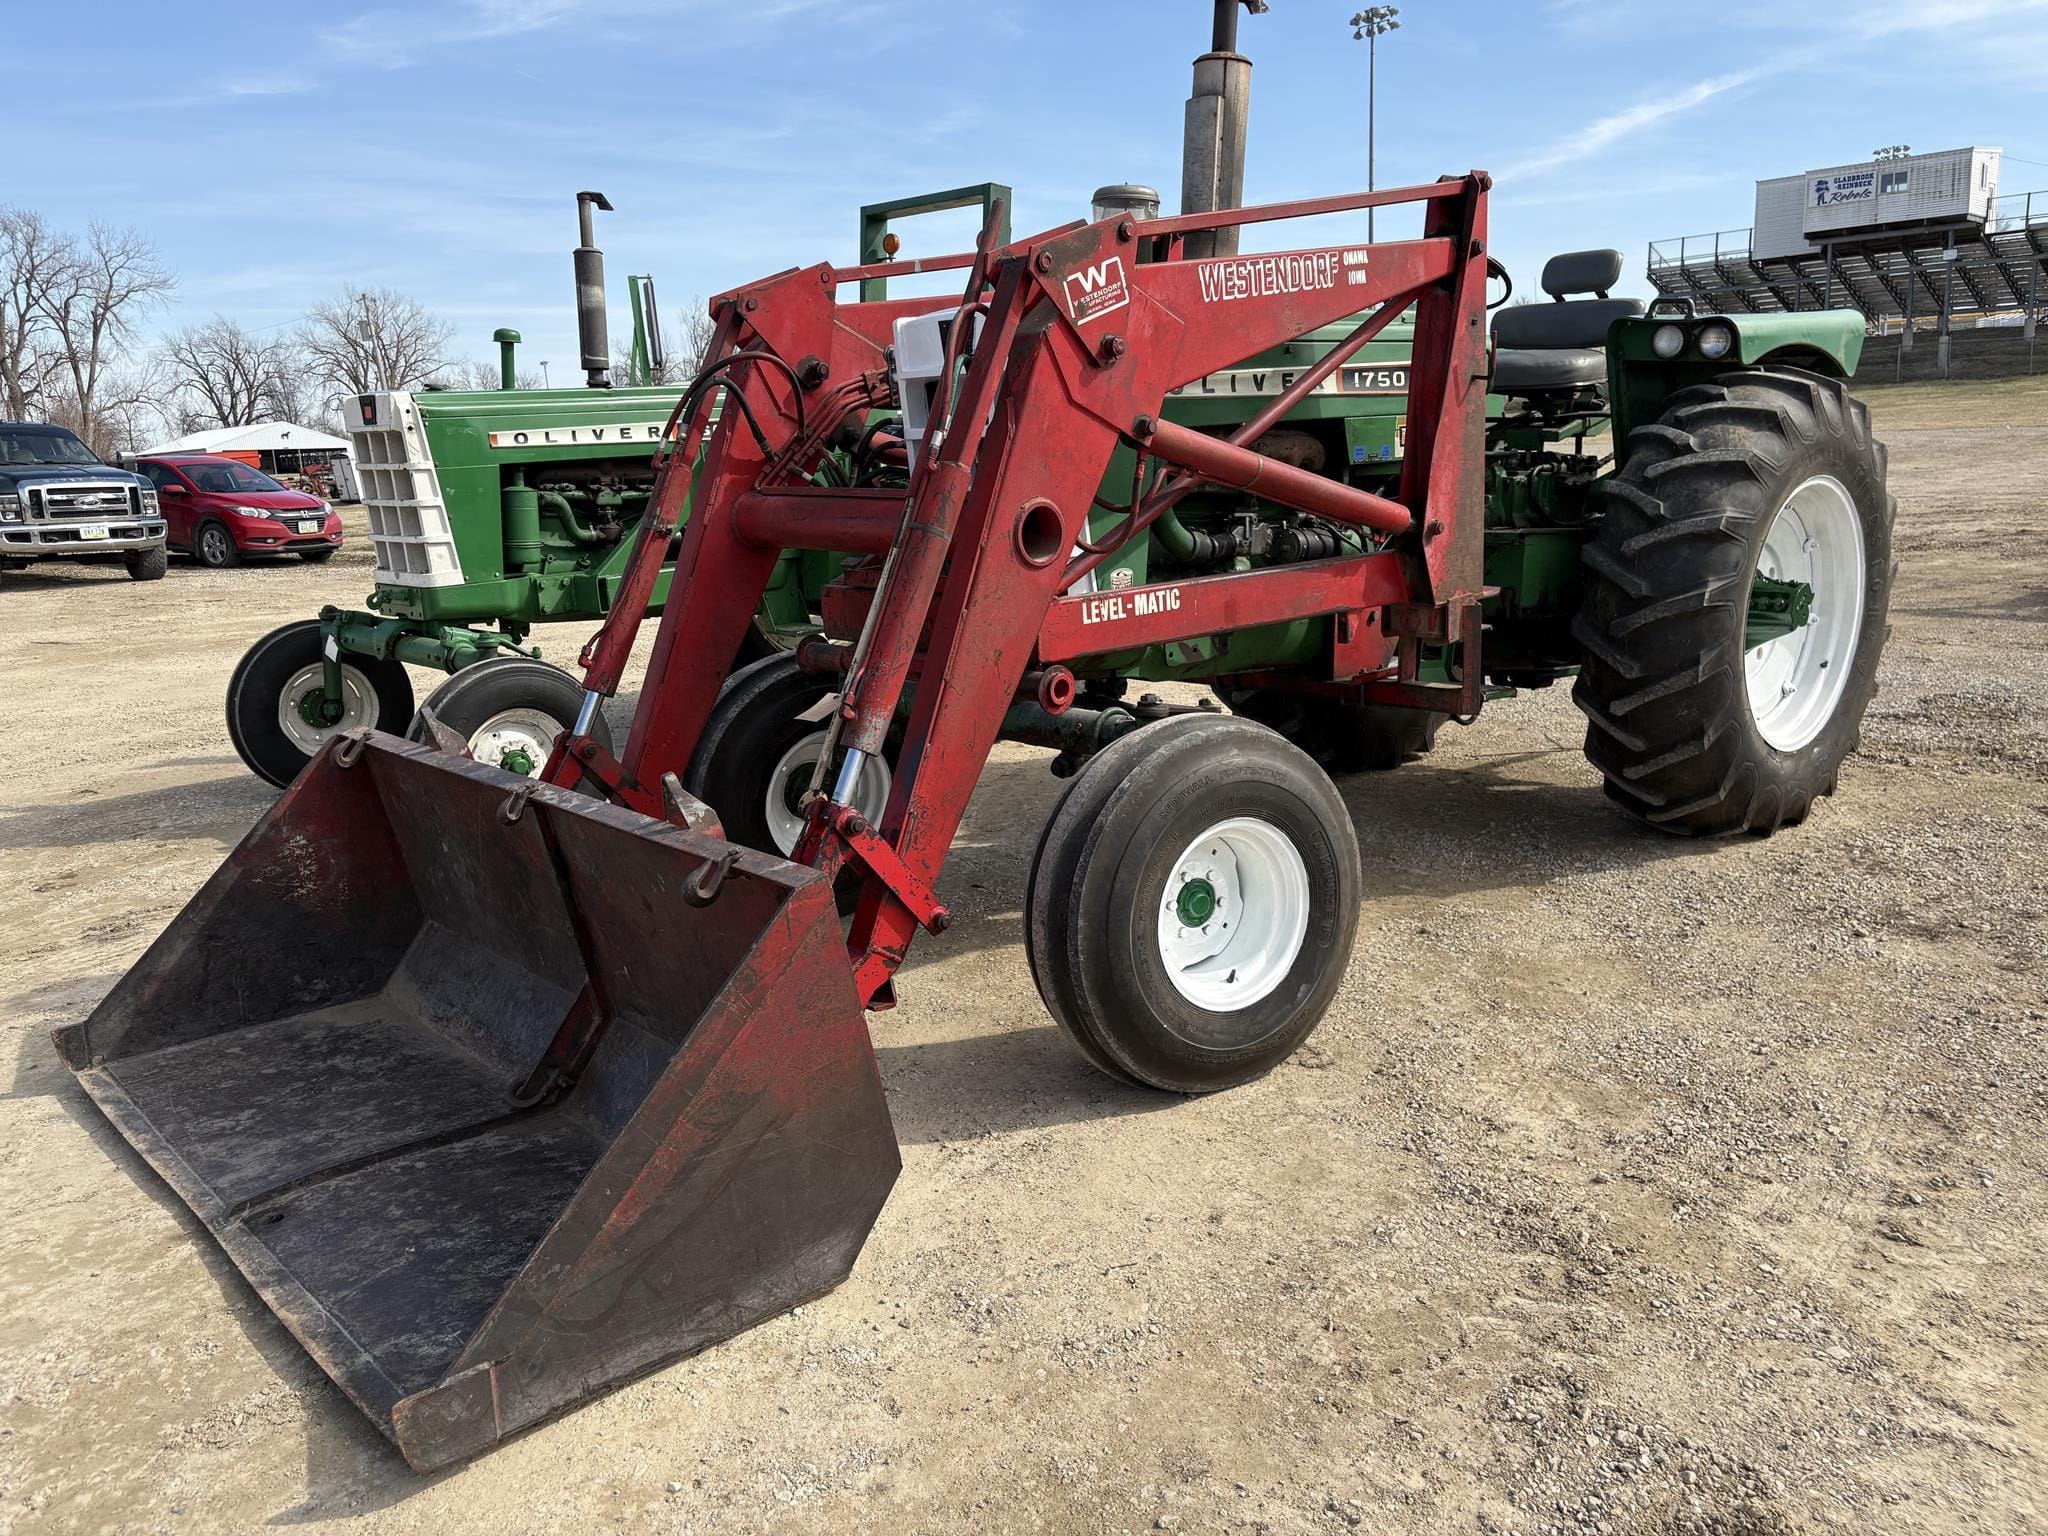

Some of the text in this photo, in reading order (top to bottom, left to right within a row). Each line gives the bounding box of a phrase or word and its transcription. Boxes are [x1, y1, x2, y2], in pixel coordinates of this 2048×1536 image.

[1834, 172, 1874, 184] GLADBROOK
[1829, 188, 1872, 204] Rebels
[1199, 250, 1368, 302] WESTENDORF ONAWA
[1348, 270, 1366, 285] IOWA
[1170, 371, 1405, 395] LIVE 1750
[514, 426, 661, 444] OLIVER
